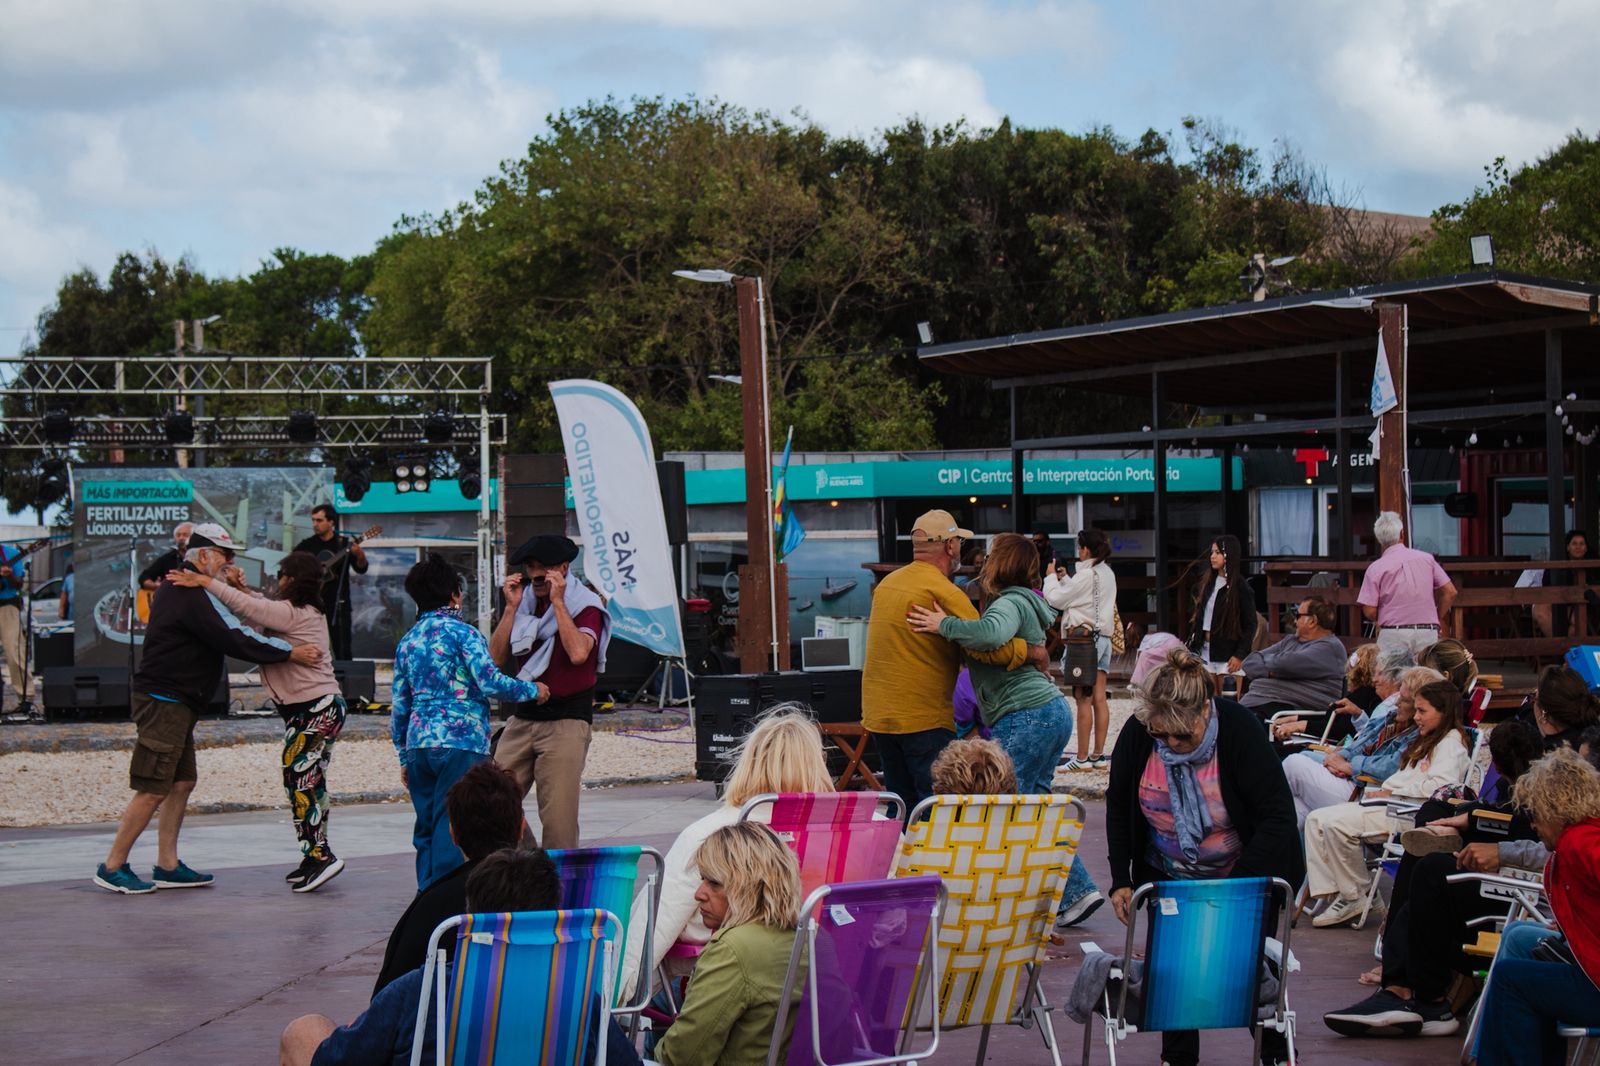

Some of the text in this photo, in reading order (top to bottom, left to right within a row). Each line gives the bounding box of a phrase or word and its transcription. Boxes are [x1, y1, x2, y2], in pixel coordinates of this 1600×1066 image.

[1331, 454, 1374, 467] AGEN
[937, 468, 962, 484] CIP
[1022, 467, 1034, 482] e
[1036, 467, 1123, 485] Interpretación
[1125, 466, 1180, 481] Porturia
[86, 485, 188, 499] MÁS IMPORTACIÓN
[86, 506, 189, 521] FERTILIZANTES
[86, 522, 135, 535] LÍQUIDOS
[136, 524, 144, 535] Y
